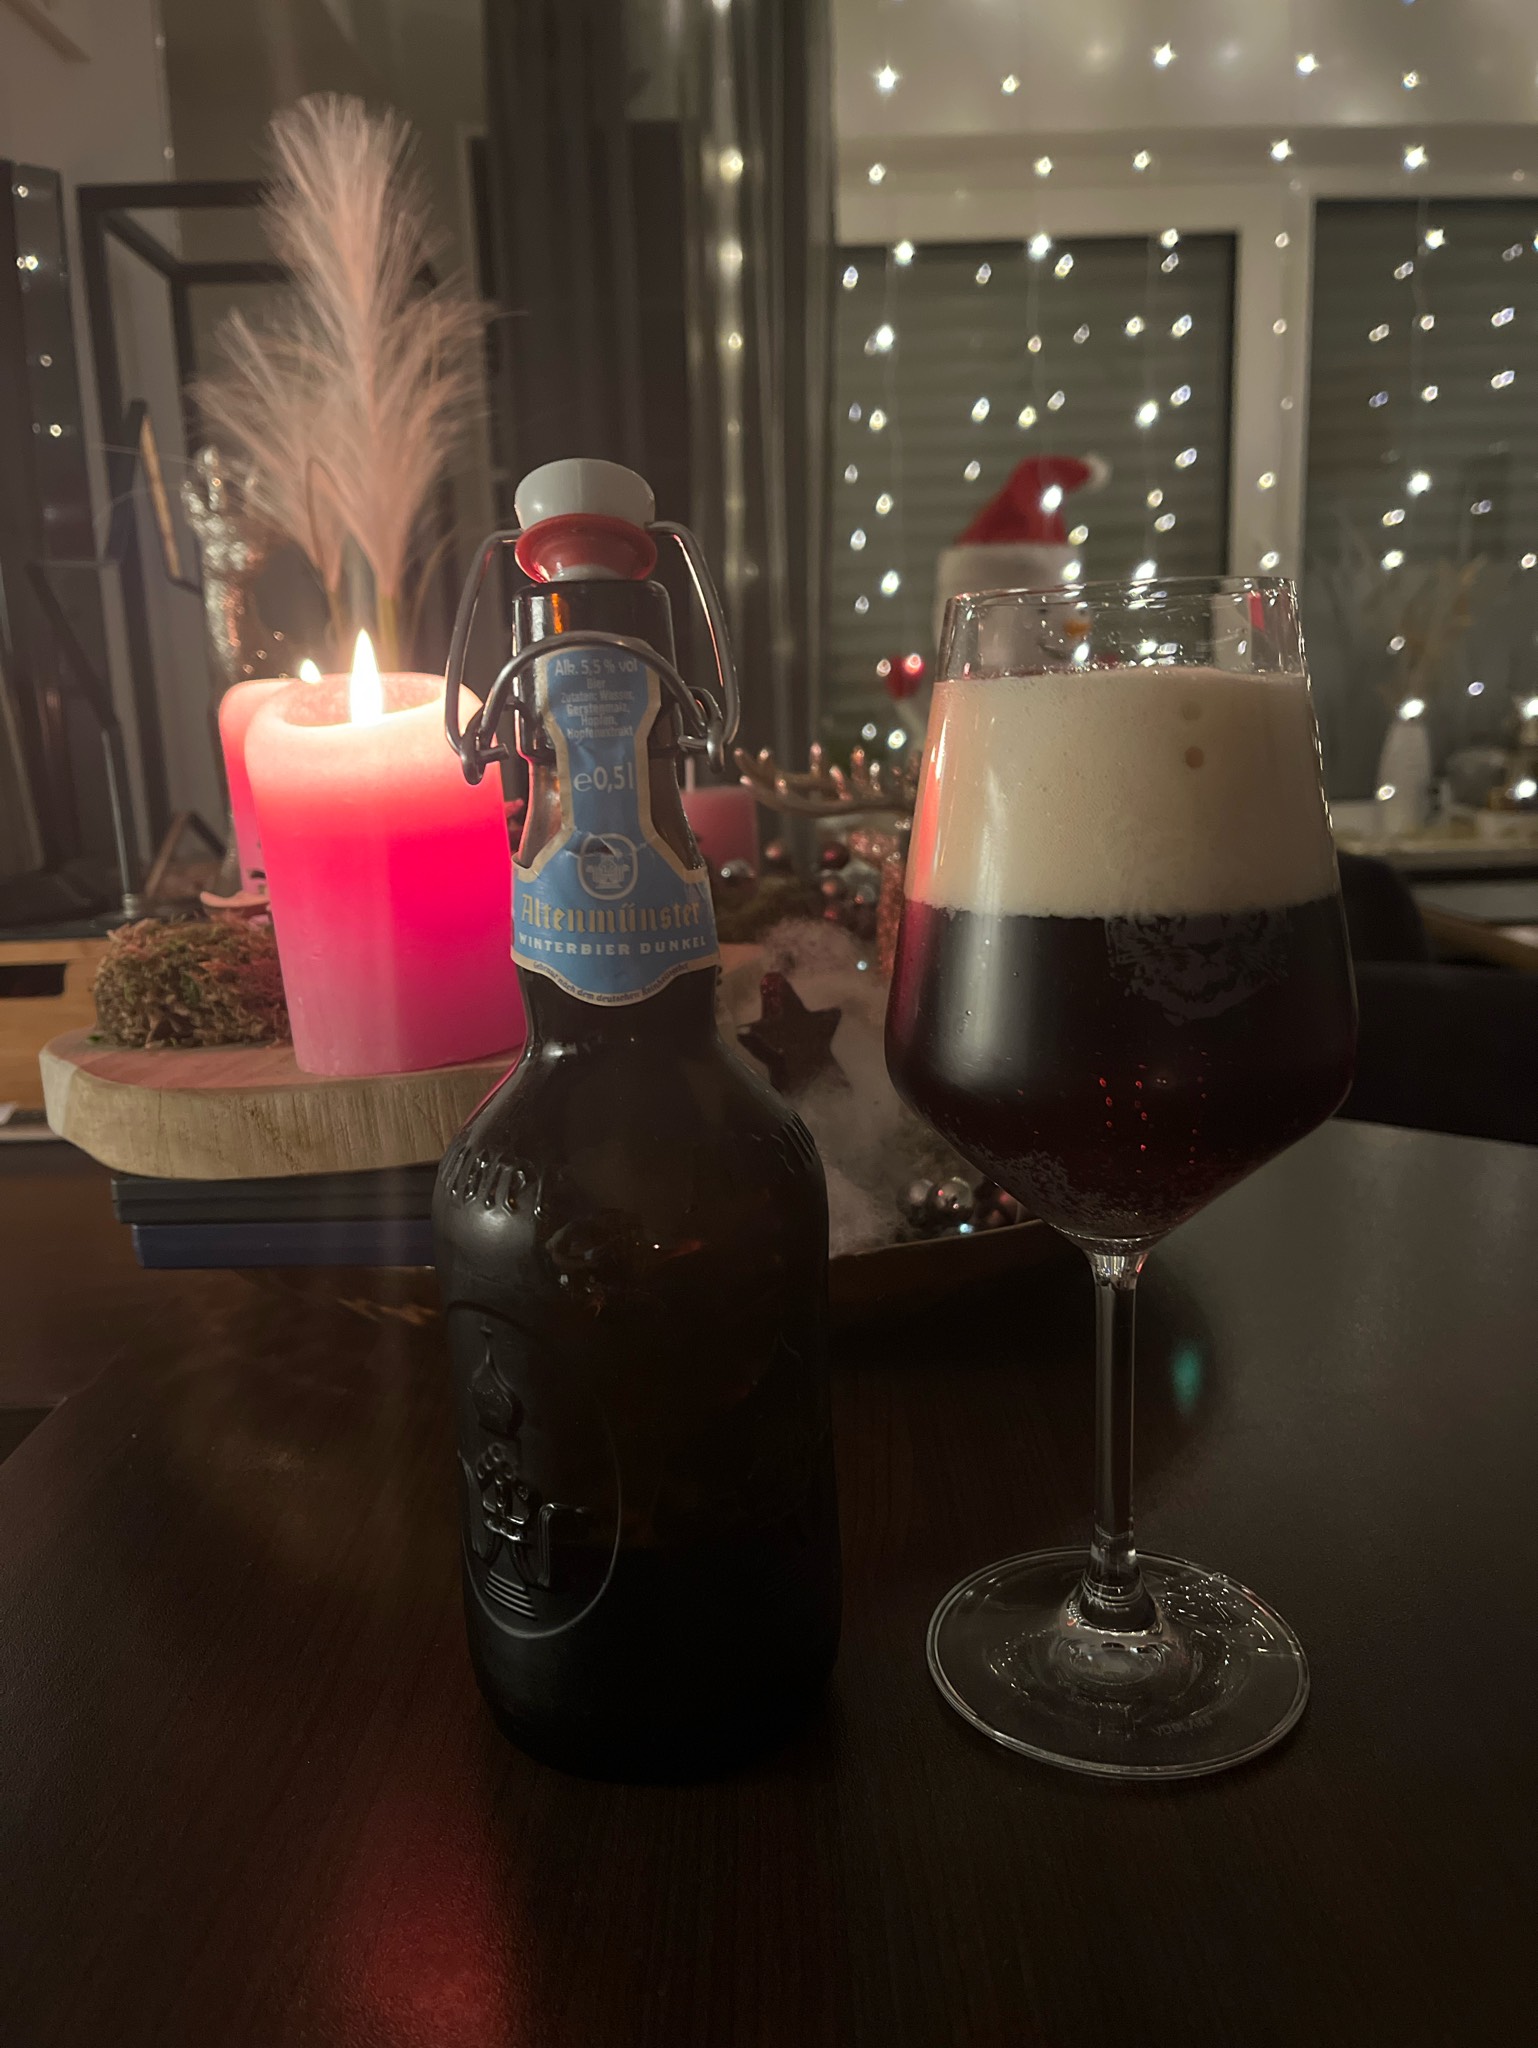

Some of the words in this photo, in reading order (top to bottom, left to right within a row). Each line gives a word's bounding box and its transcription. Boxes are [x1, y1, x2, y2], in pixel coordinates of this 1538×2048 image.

[555, 658, 579, 676] Alk.
[581, 658, 602, 676] 5,5
[604, 658, 615, 674] %
[618, 658, 638, 672] vol
[521, 893, 701, 935] Altenmünster
[518, 932, 631, 955] WINTERBIER
[639, 935, 707, 955] DUNKEL
